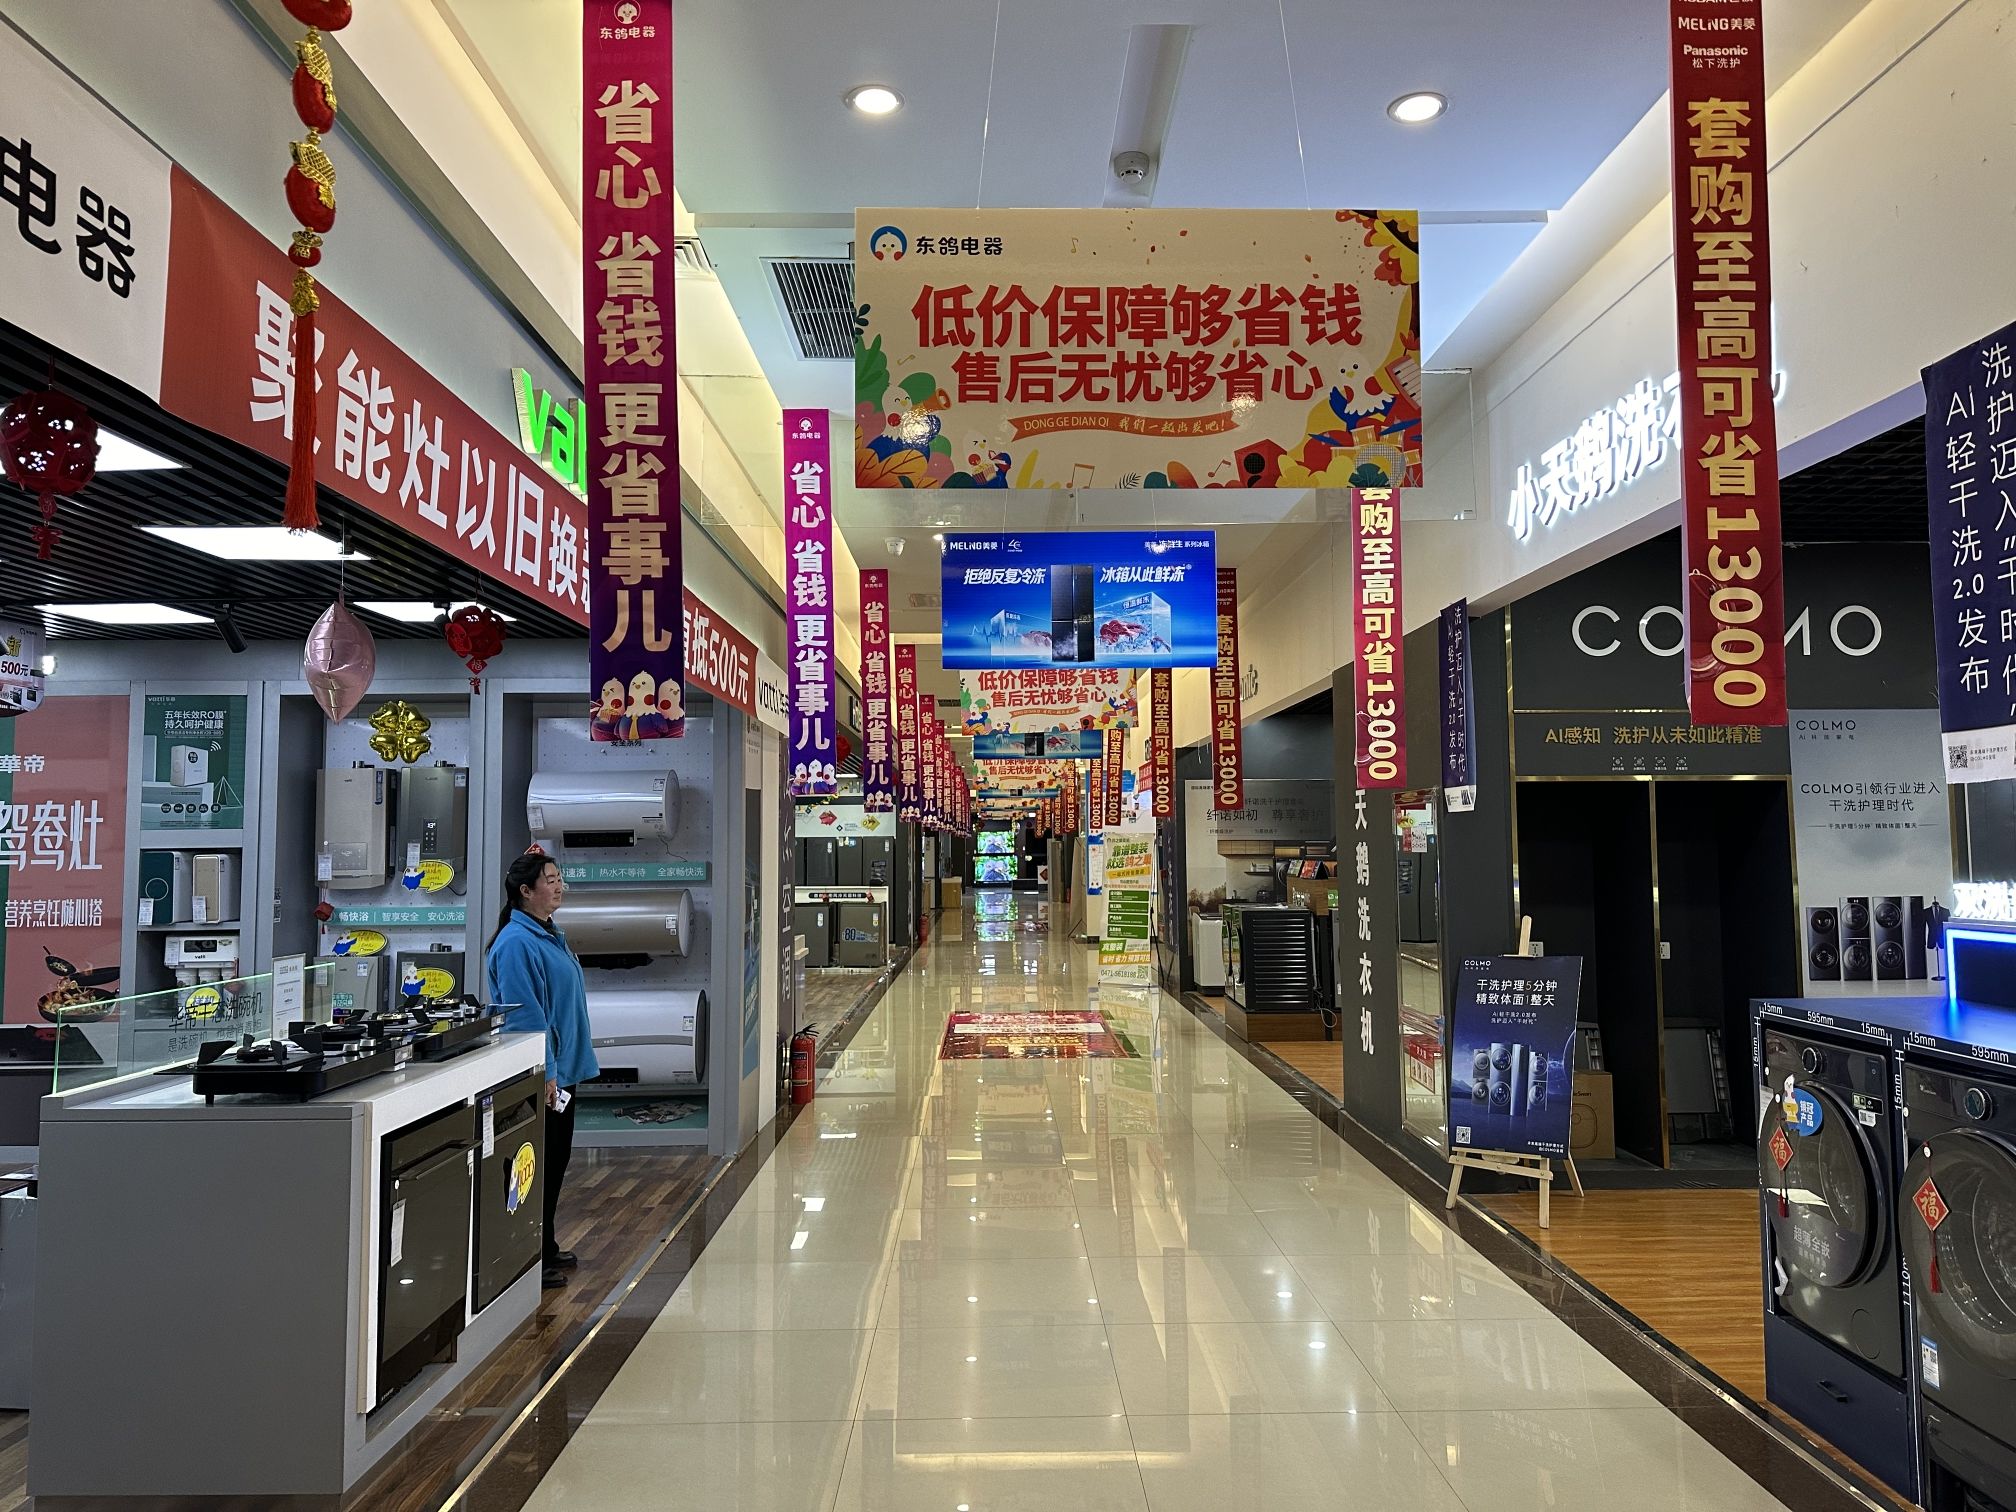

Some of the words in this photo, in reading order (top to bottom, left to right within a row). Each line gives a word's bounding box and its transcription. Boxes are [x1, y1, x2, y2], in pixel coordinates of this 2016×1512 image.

[600, 26, 656, 40] 东鸽电器
[1684, 44, 1748, 56] Panasonic
[1692, 58, 1740, 69] 松下洗护
[594, 79, 663, 209] 省心
[0, 137, 137, 299] 电器
[915, 235, 1004, 256] 东鸽电器
[595, 231, 665, 368] 省钱
[911, 283, 1363, 348] 低价保障够省钱
[952, 350, 1323, 403] 售后无忧够省心
[1687, 97, 1767, 707] 套购至高可省13000
[1023, 417, 1056, 431] DONG
[1057, 416, 1074, 428] GE
[1076, 415, 1097, 427] DIAN
[1098, 415, 1111, 428] QI
[790, 460, 826, 528] 省心
[599, 383, 673, 653] 更省事儿
[792, 539, 828, 607] 省钱
[964, 568, 1047, 585] 拒绝反复冷冻
[1100, 567, 1186, 584] 冰箱从此鲜冻
[864, 601, 887, 644] 省心
[1572, 605, 1882, 656] COO
[794, 614, 831, 751] 更省事儿
[865, 651, 888, 694] 省钱
[898, 667, 914, 699] 省心
[978, 668, 1119, 691] 低价保障够省钱
[991, 686, 1107, 708] 售后无忧够省心
[899, 704, 916, 736] 省钱
[1796, 720, 1856, 731] COLMO
[867, 698, 890, 785] 更省事儿
[1545, 727, 1600, 745] AI感知
[1613, 726, 1762, 745] 洗护从未如此精准
[901, 738, 918, 802] 更省事儿
[1801, 782, 1940, 795] COLMO引领行业进入
[1206, 809, 1258, 821] 纤诺如初
[1829, 799, 1914, 812] 干洗护理时代
[600, 868, 646, 878] 热水不等待
[5, 899, 103, 928] 营养烹饪随心搭
[339, 911, 369, 922] 畅快浴
[382, 911, 419, 922] 智享安全
[428, 911, 465, 922] 安心洗浴
[1354, 789, 1375, 1055] 天鹅洗衣机
[1477, 979, 1558, 992] 干洗护理5分钟
[1476, 993, 1555, 1006] 精致体面1整天
[1807, 1011, 1834, 1026] 595mm
[1861, 1022, 1885, 1037] 15mm
[1908, 1031, 1936, 1047] 15mm
[1971, 1043, 2009, 1064] 595mm
[1895, 1073, 1903, 1110] 15mm
[1774, 1136, 1787, 1161] 福
[1918, 1189, 1940, 1220] 福
